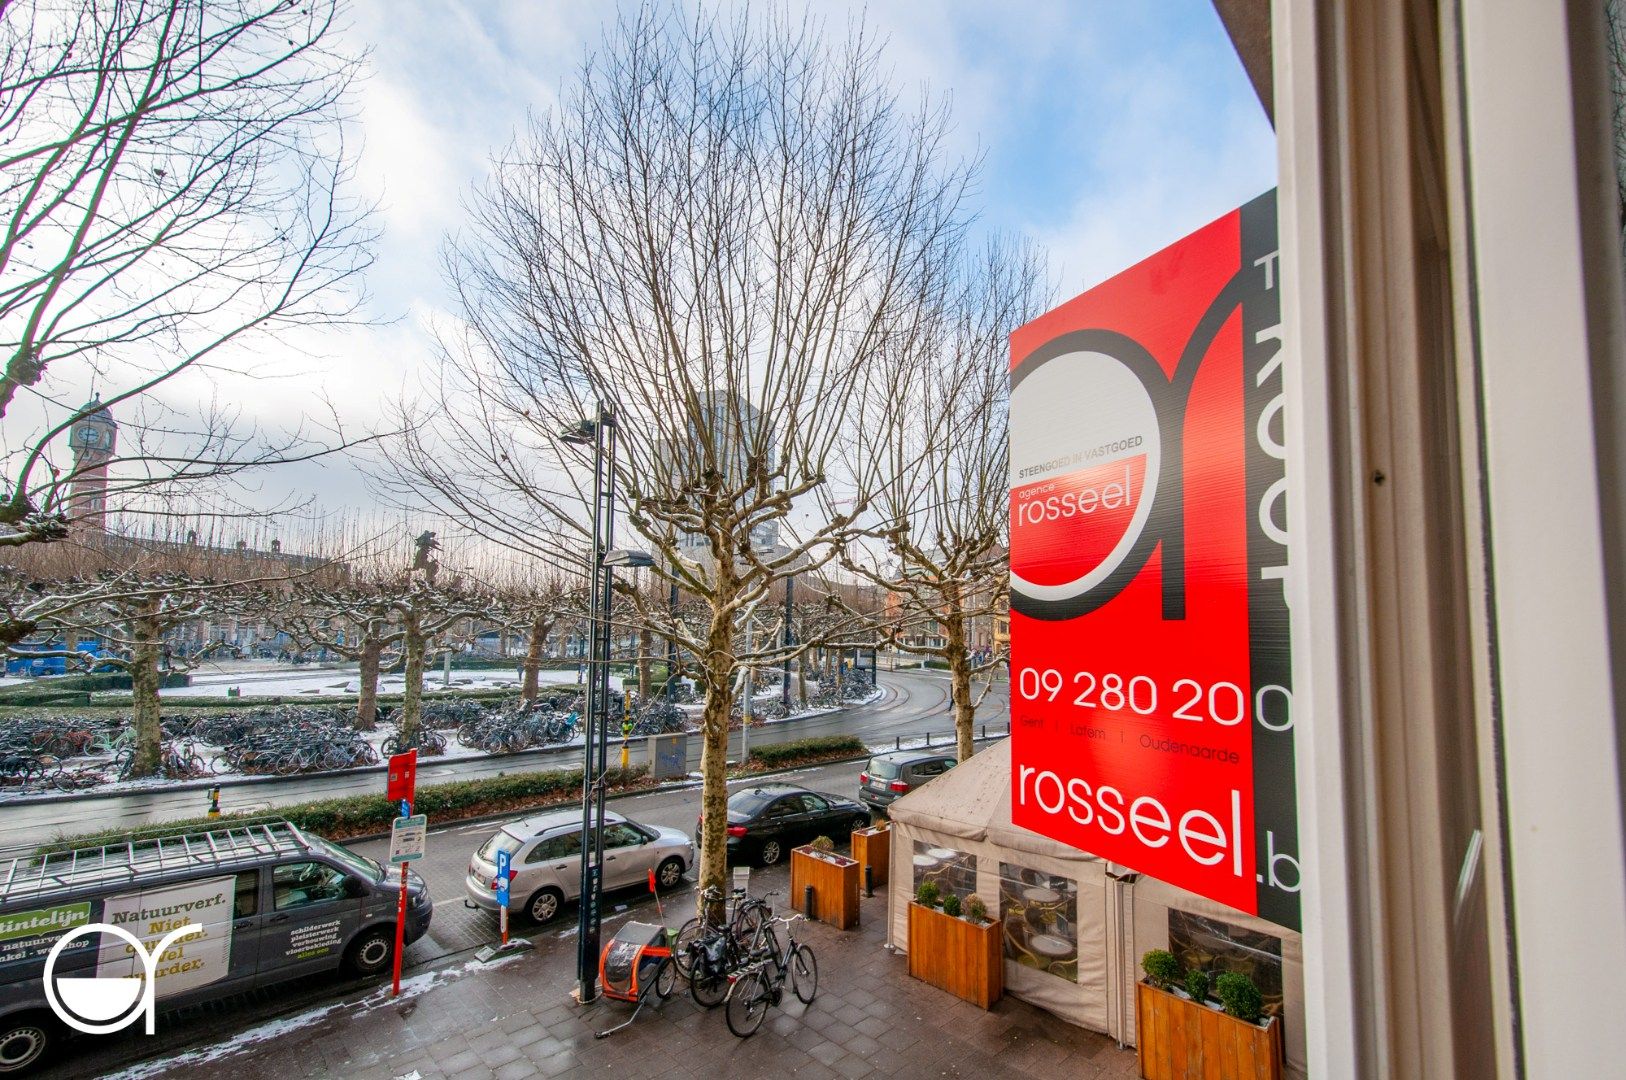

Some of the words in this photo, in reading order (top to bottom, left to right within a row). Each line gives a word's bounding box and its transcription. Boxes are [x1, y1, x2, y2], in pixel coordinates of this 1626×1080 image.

[1019, 455, 1072, 479] STEENGOED
[1073, 453, 1083, 464] IN
[1084, 435, 1143, 461] VASTGOED
[1018, 464, 1131, 527] rosseel
[1019, 483, 1055, 500] agence
[1019, 667, 1063, 702] 09
[1073, 671, 1158, 715] 280
[1021, 715, 1044, 729] Gent
[1070, 723, 1106, 740] Latem
[1139, 734, 1240, 764] Oudenaarde
[1019, 764, 1301, 892] rosseel.b
[499, 853, 507, 875] P
[111, 893, 226, 925] Natuurverf.
[148, 915, 191, 934] Niet
[290, 920, 341, 935] schilderwerk
[3, 934, 66, 952] natuurve
[290, 927, 340, 943] pleisterwerk
[292, 933, 337, 948] verbouwing
[285, 938, 342, 955] vloerbekleding
